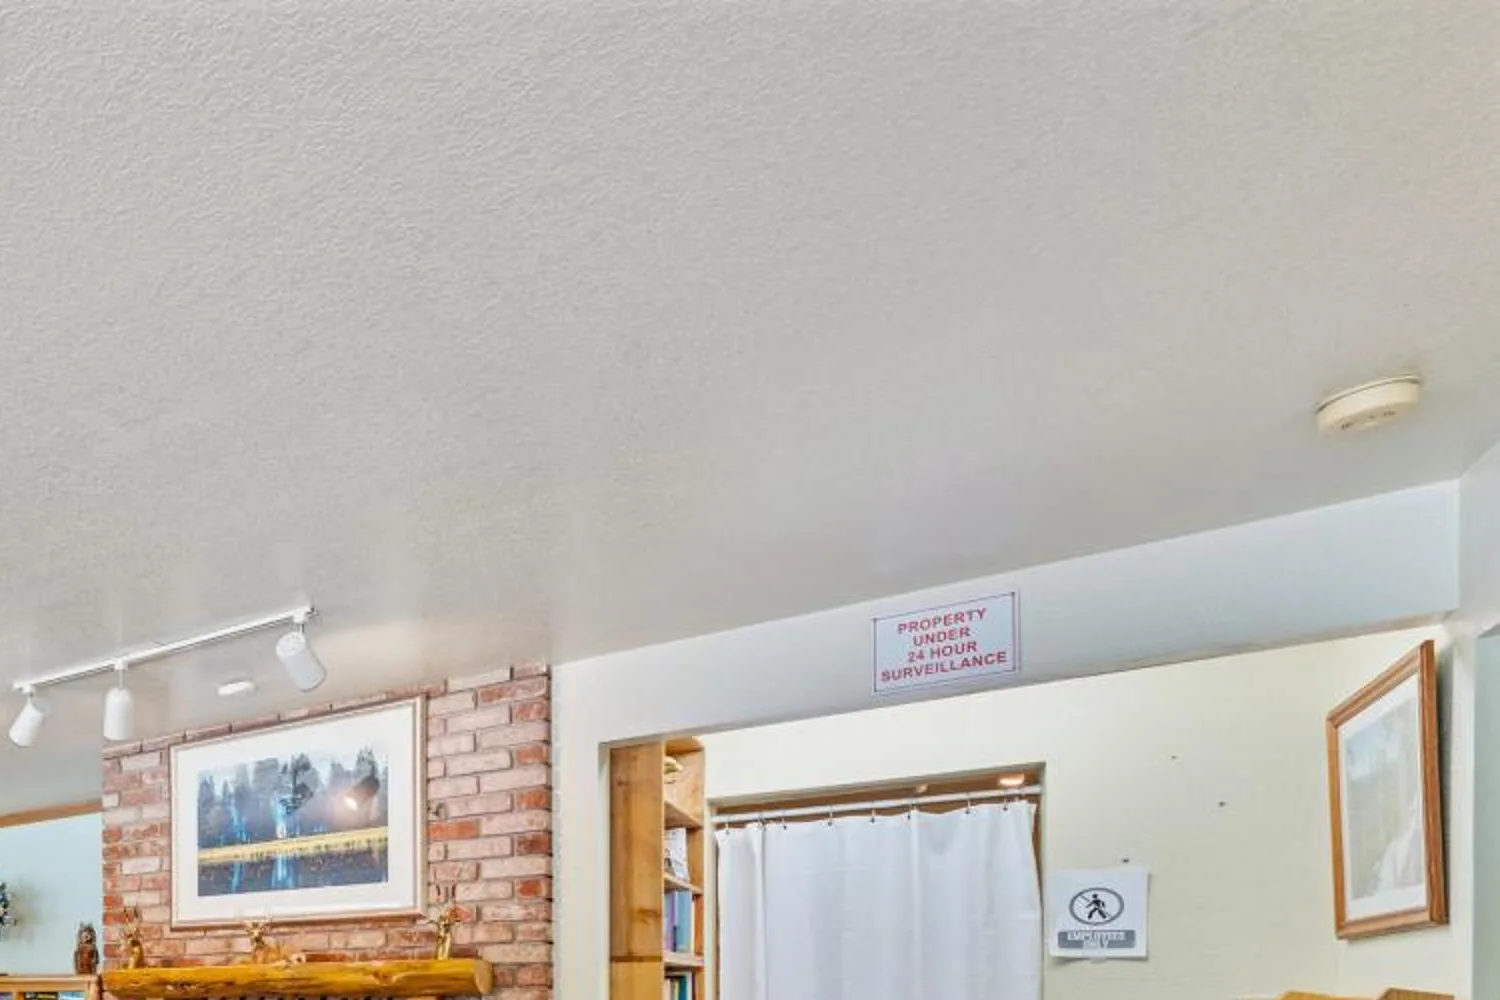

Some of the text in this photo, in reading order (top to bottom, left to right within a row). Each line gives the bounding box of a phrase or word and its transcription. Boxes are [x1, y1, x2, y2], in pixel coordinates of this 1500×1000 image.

[898, 608, 987, 634] PROPERTY
[912, 627, 971, 647] UNDER
[907, 641, 978, 663] 24 HOUR
[880, 651, 1008, 682] SURVEILLANCE
